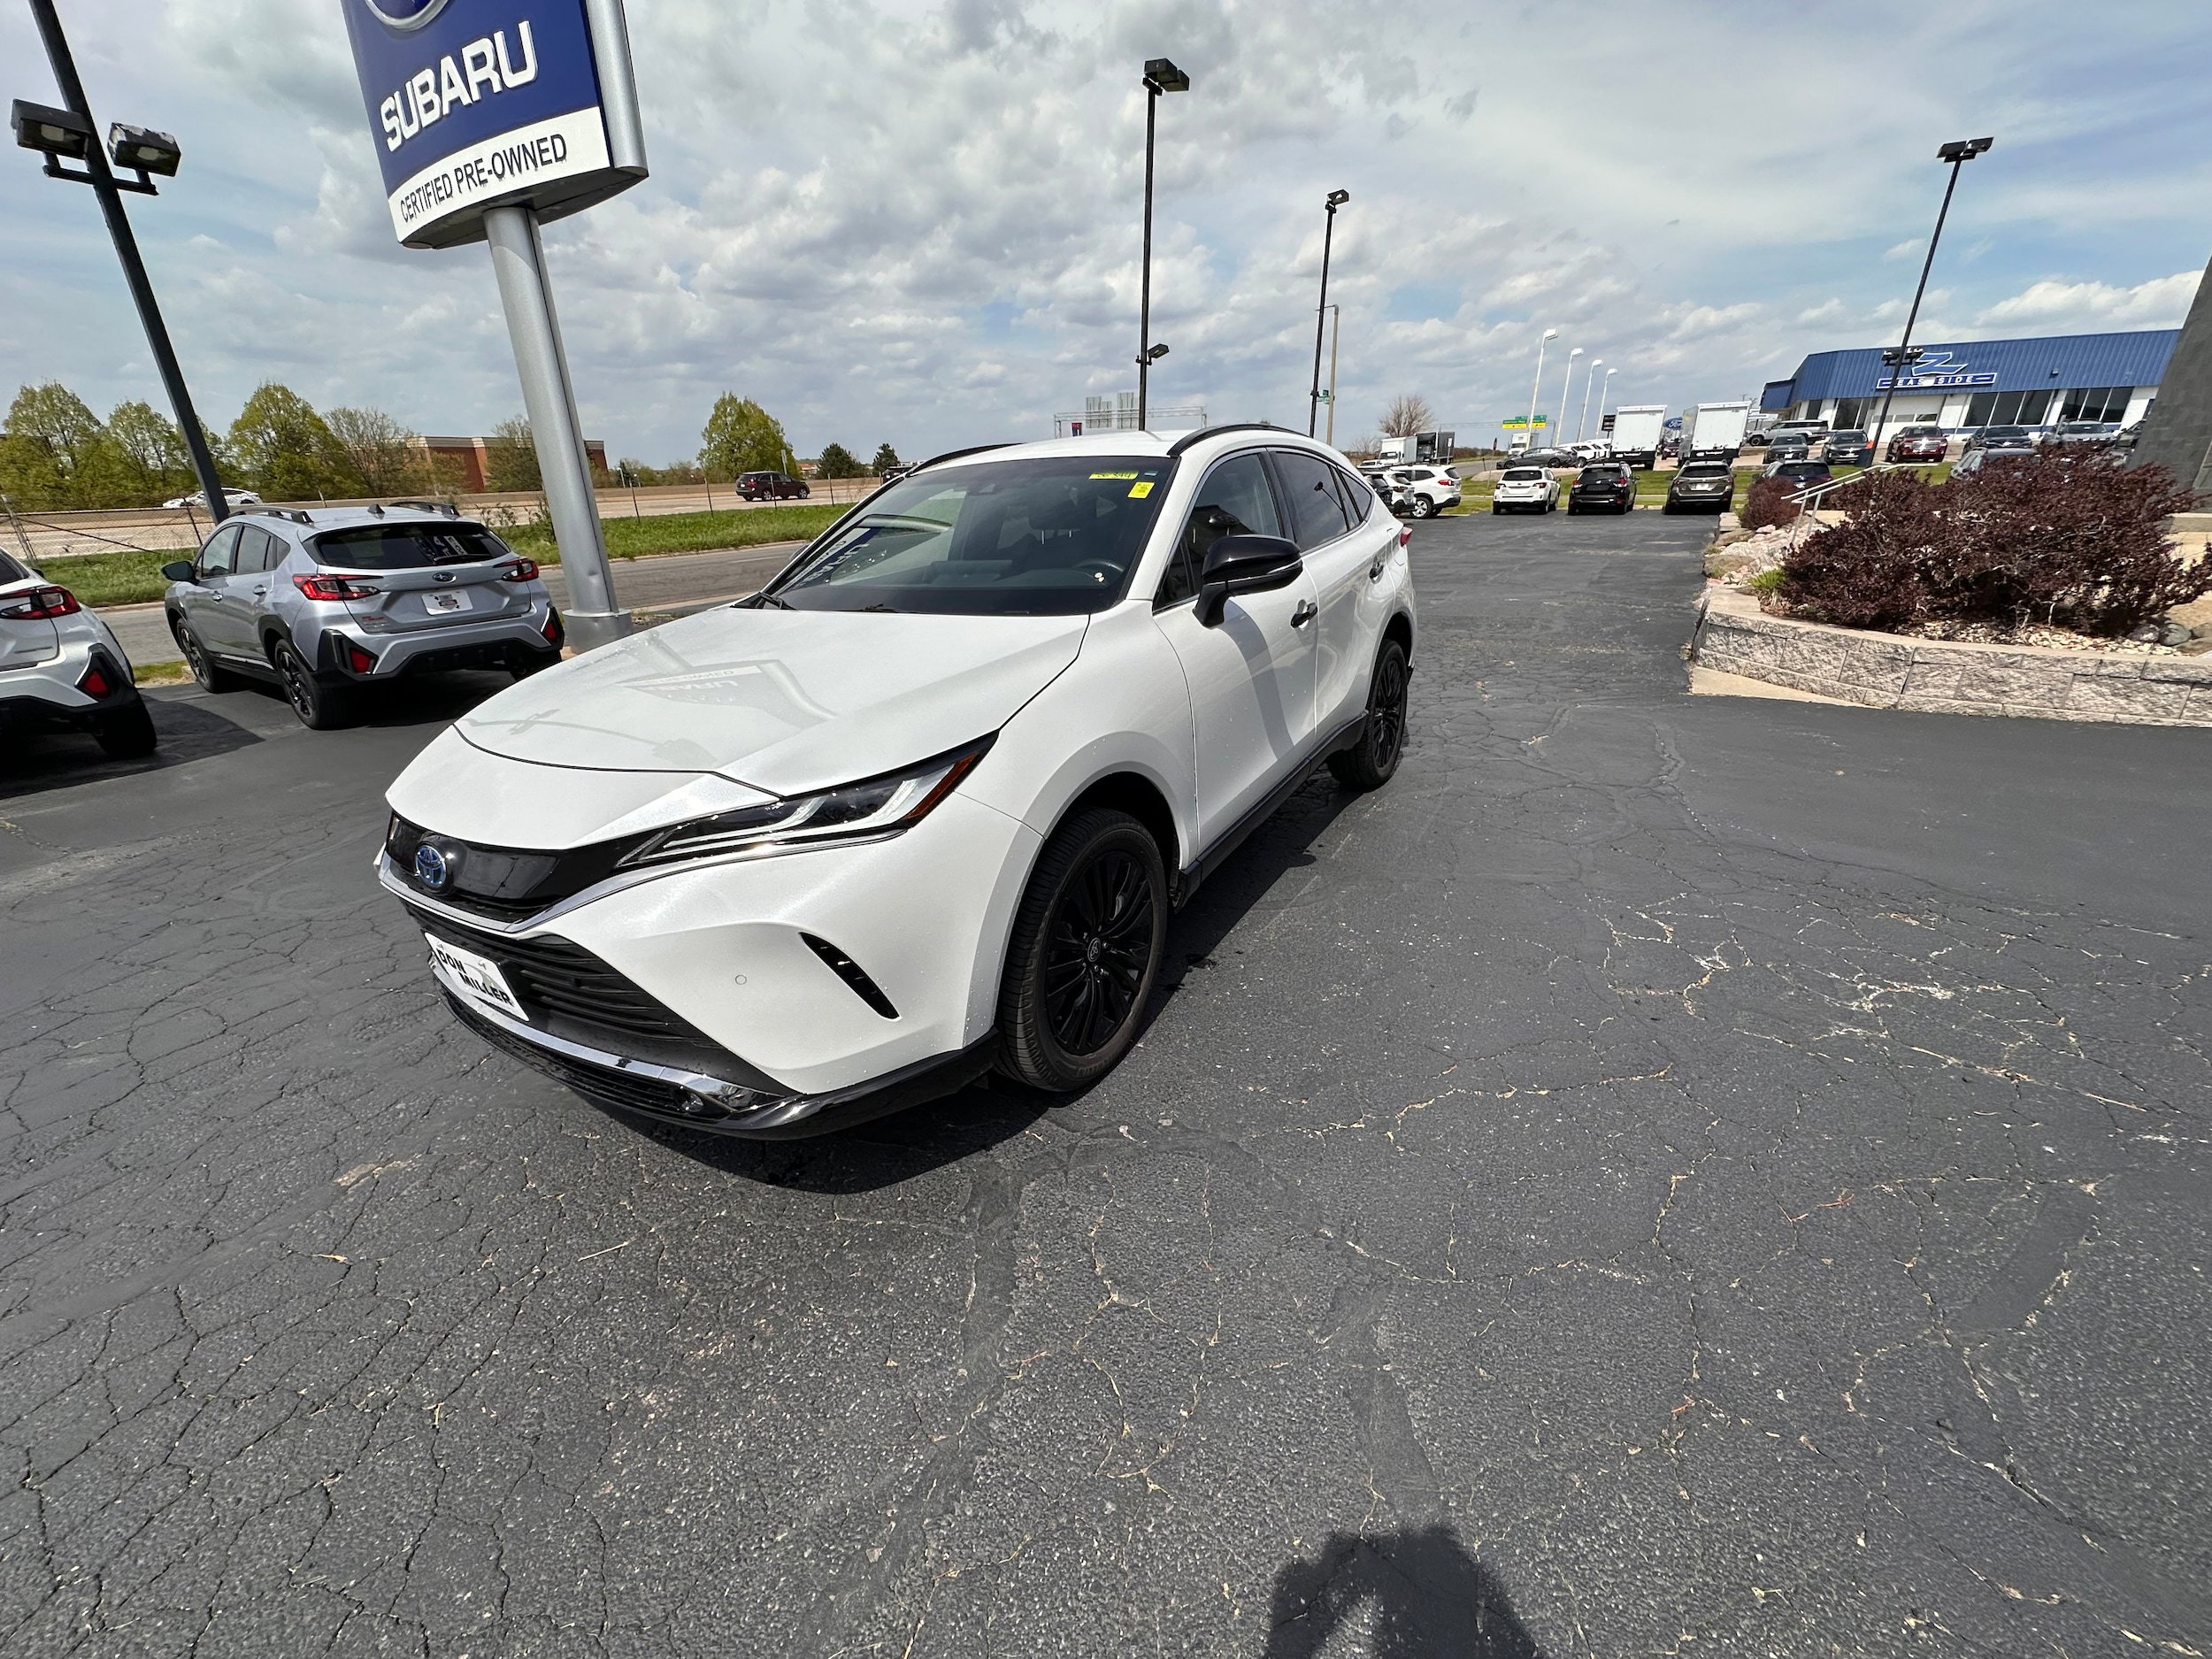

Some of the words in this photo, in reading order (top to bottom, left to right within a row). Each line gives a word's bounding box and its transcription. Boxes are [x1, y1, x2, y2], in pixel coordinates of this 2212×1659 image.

[380, 20, 538, 152] SUBARU
[400, 173, 453, 223] CERTIFIED
[454, 134, 567, 196] PRE-OWNED
[1897, 378, 1931, 387] EAS
[1938, 375, 1974, 385] SIDE
[436, 948, 467, 975] DON
[458, 972, 516, 1007] MILLER
